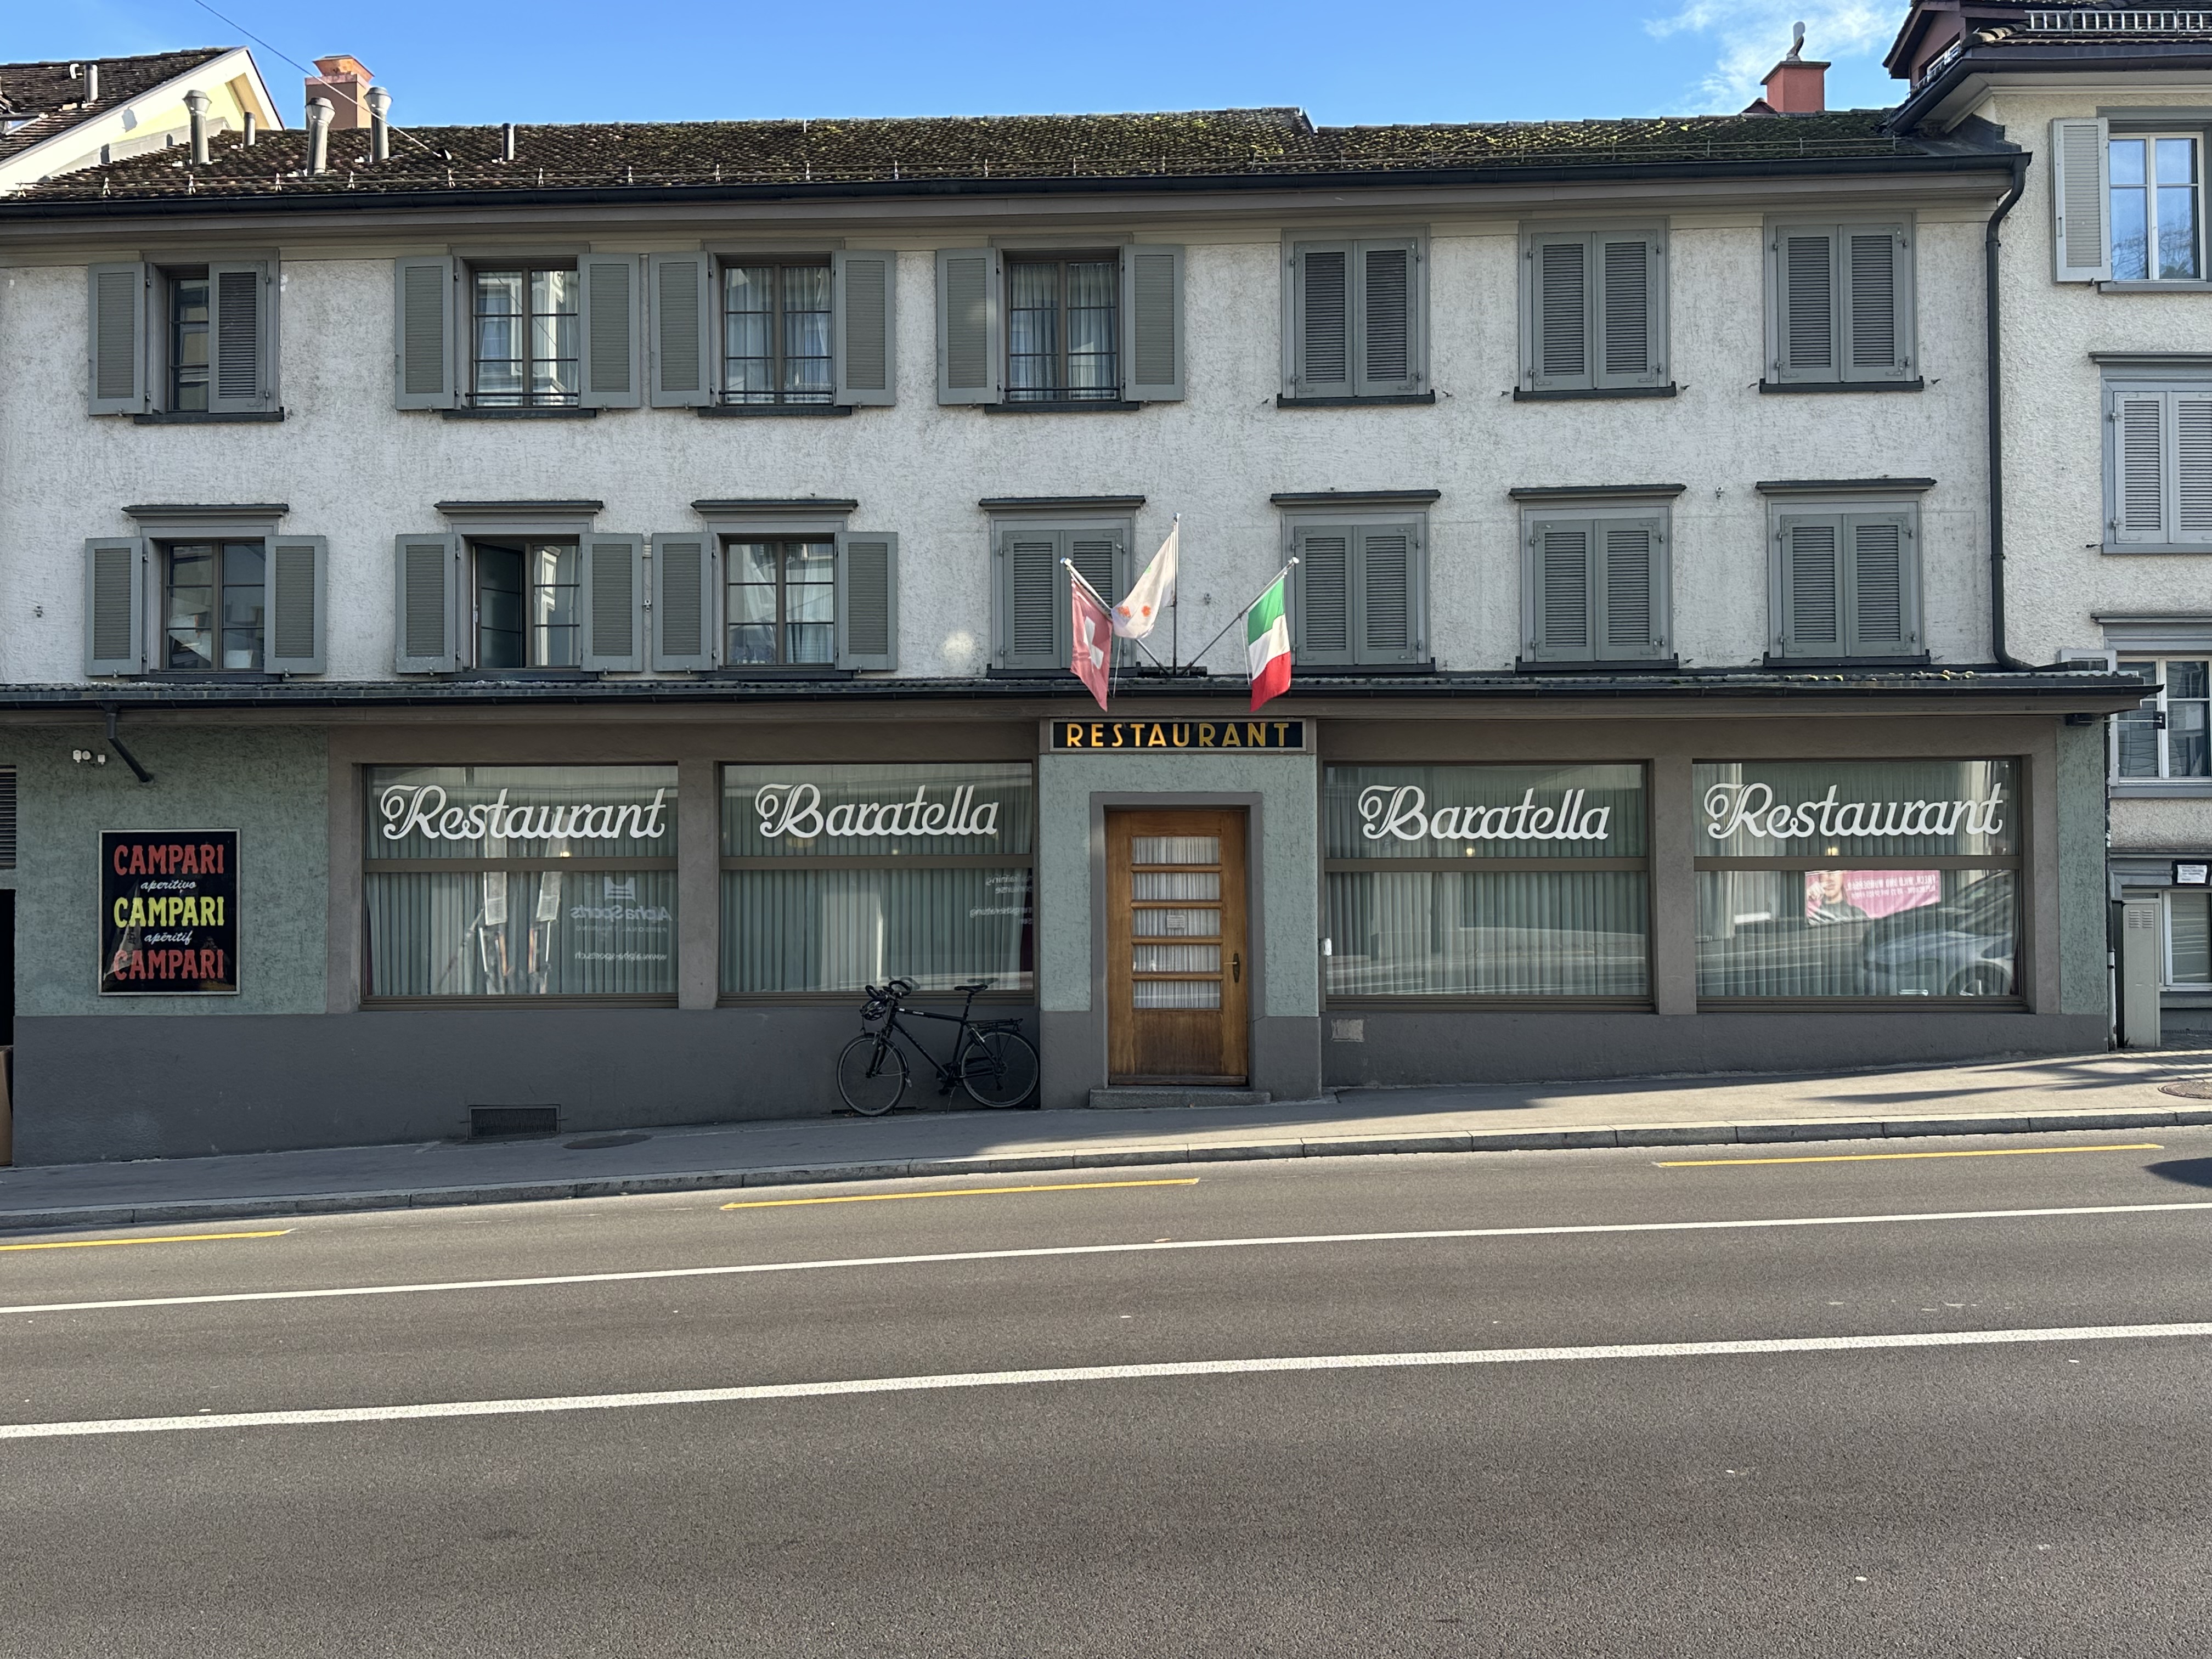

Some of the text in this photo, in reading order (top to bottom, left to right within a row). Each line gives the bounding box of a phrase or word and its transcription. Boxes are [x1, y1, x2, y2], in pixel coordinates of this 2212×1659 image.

[1066, 723, 1289, 747] RESTAURANT
[380, 785, 667, 840] Restaurant
[754, 783, 1000, 838] Baratella
[1358, 785, 1611, 840] Baratella
[1703, 782, 2004, 839] Restaurant
[114, 844, 224, 876] CAMPARI
[140, 879, 197, 893] aperitivo
[114, 896, 225, 928] CAMPARI
[114, 949, 224, 981] CAMPARI
